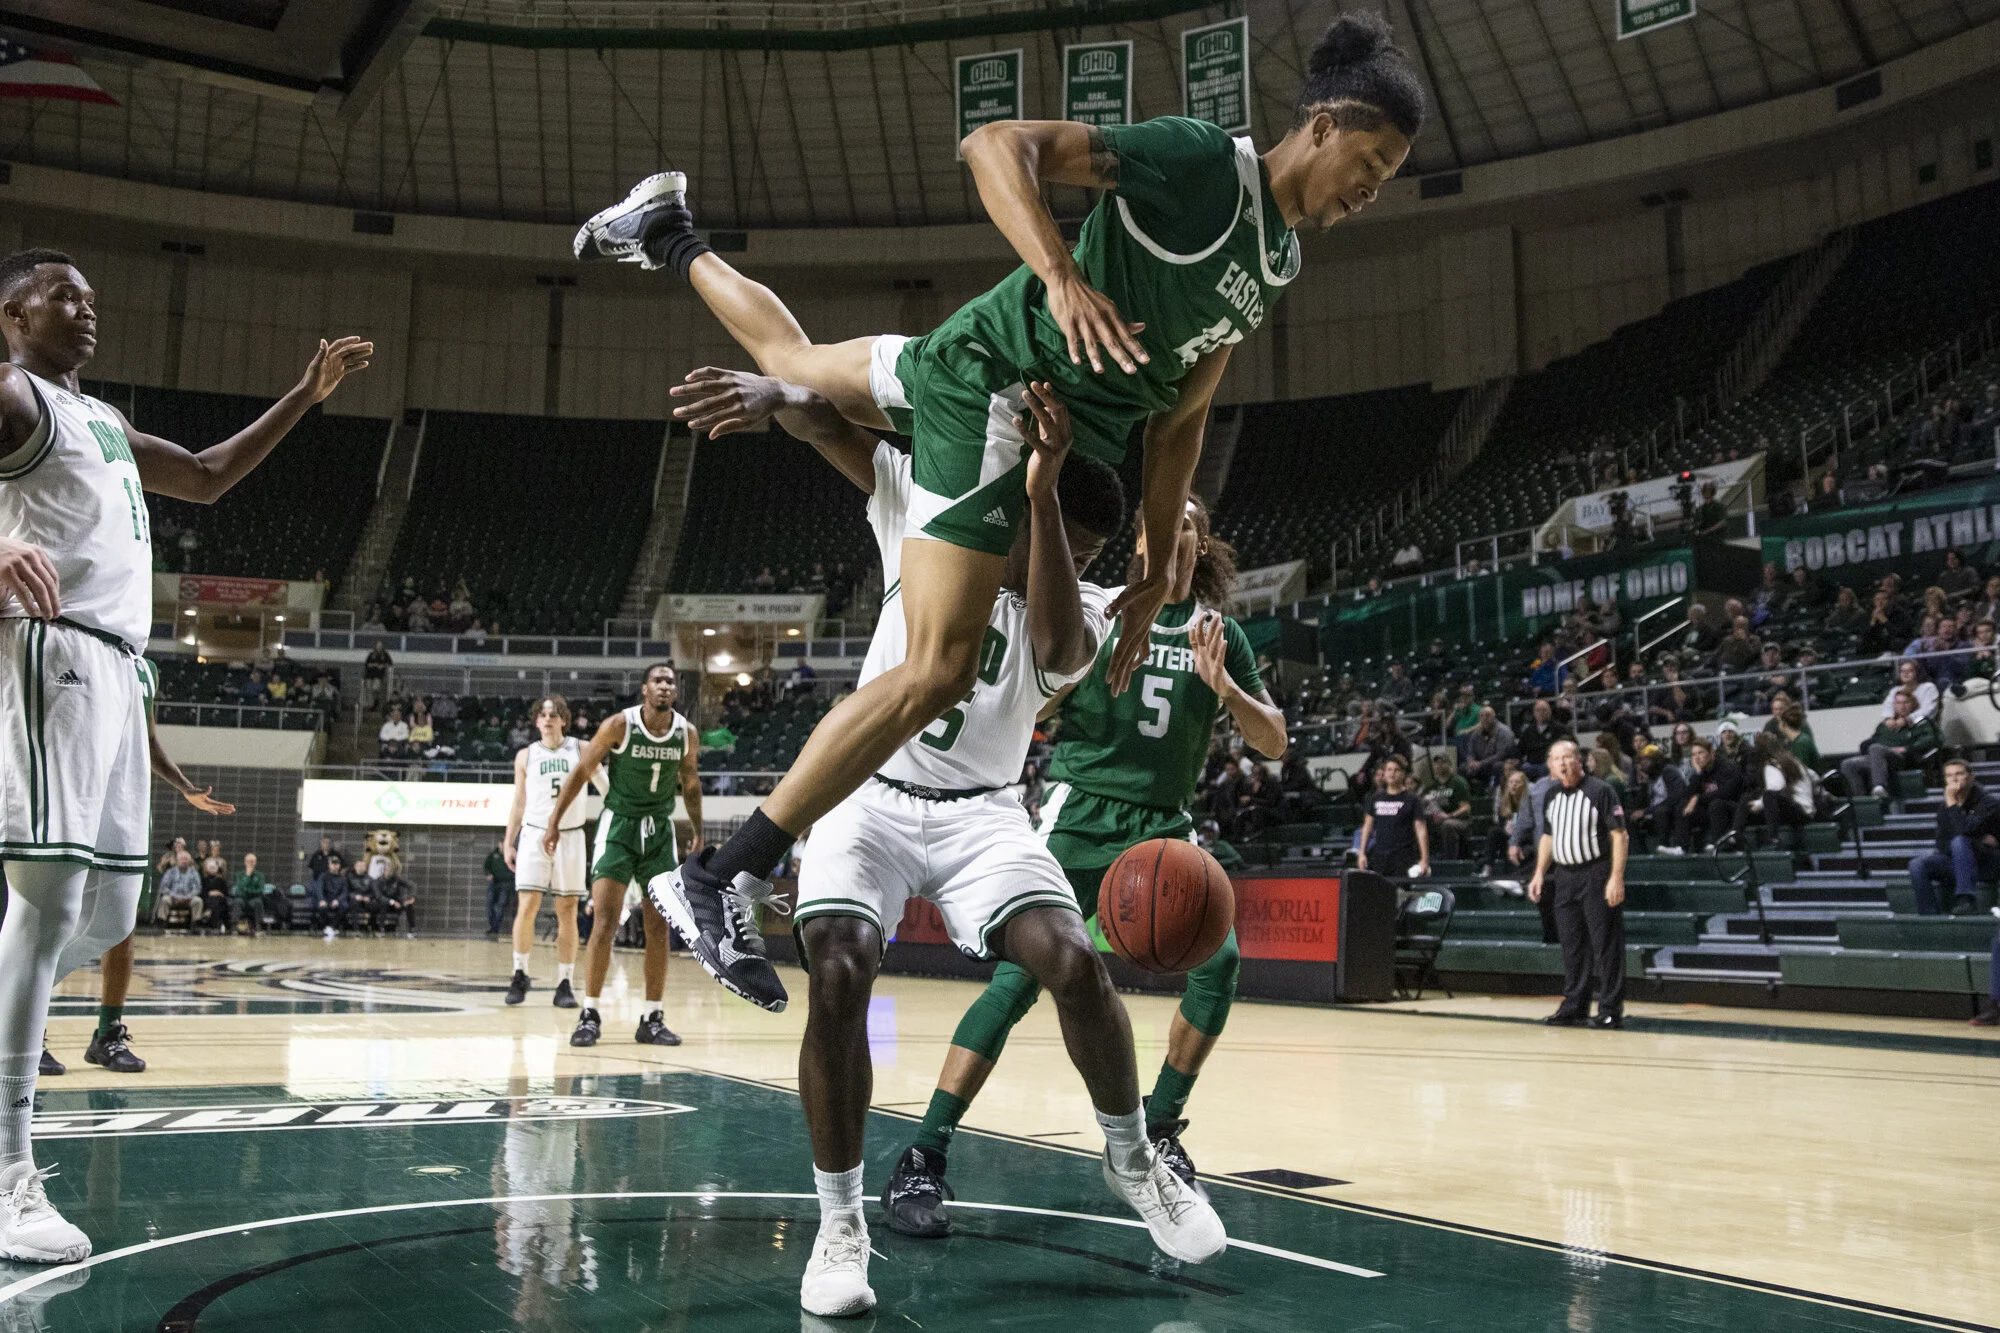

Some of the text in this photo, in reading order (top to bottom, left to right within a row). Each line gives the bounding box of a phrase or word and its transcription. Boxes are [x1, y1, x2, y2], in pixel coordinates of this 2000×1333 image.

[1197, 31, 1233, 59] OHIO
[970, 60, 1008, 84] OHIO
[1080, 50, 1117, 75] OHIO
[1073, 99, 1121, 110] CHAMPIONS
[1785, 522, 1904, 574] BOBCAT
[1523, 561, 1687, 618] HOME OF OHIO
[1138, 674, 1173, 738] 5
[631, 744, 682, 761] EASTERN
[540, 758, 569, 776] OHIO
[650, 762, 661, 793] 1
[1273, 927, 1325, 943] SYSTEM
